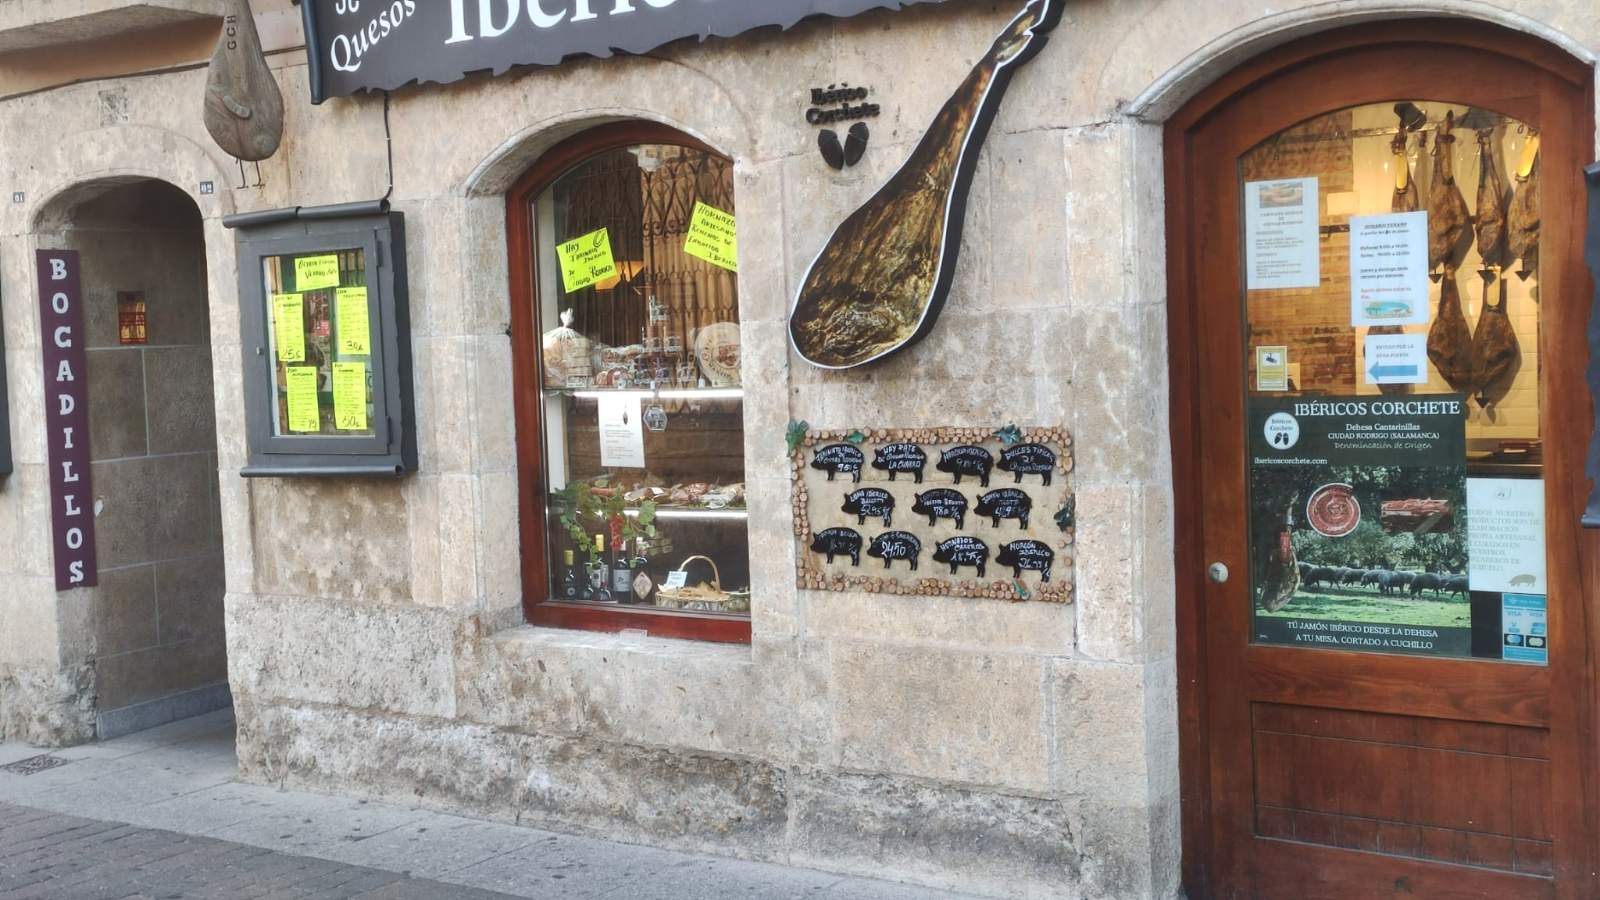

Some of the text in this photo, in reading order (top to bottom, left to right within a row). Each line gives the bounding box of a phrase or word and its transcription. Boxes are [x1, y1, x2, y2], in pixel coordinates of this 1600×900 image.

[330, 0, 417, 72] Quesos
[1294, 400, 1461, 416] IBÉRICOS CORCHETE
[50, 258, 84, 584] BOCADILLOS
[1345, 423, 1420, 431] Dehesa Cantarinillas
[1328, 432, 1440, 440] CIUDAD RODRIGO (SALAMANCA)
[883, 445, 897, 454] HAY
[1004, 446, 1032, 460] DULCES
[1394, 441, 1403, 449] de
[1404, 442, 1433, 451] Origen
[1254, 457, 1328, 465] ibericoscorchete.com
[1287, 621, 1438, 638] TÚ JAMÓN IBÉRICO DESDE LA DEHESA
[1303, 634, 1314, 642] TU
[1341, 636, 1381, 647] CORTADO
[1382, 639, 1390, 647] A
[1390, 640, 1433, 649] CUCHILLO
